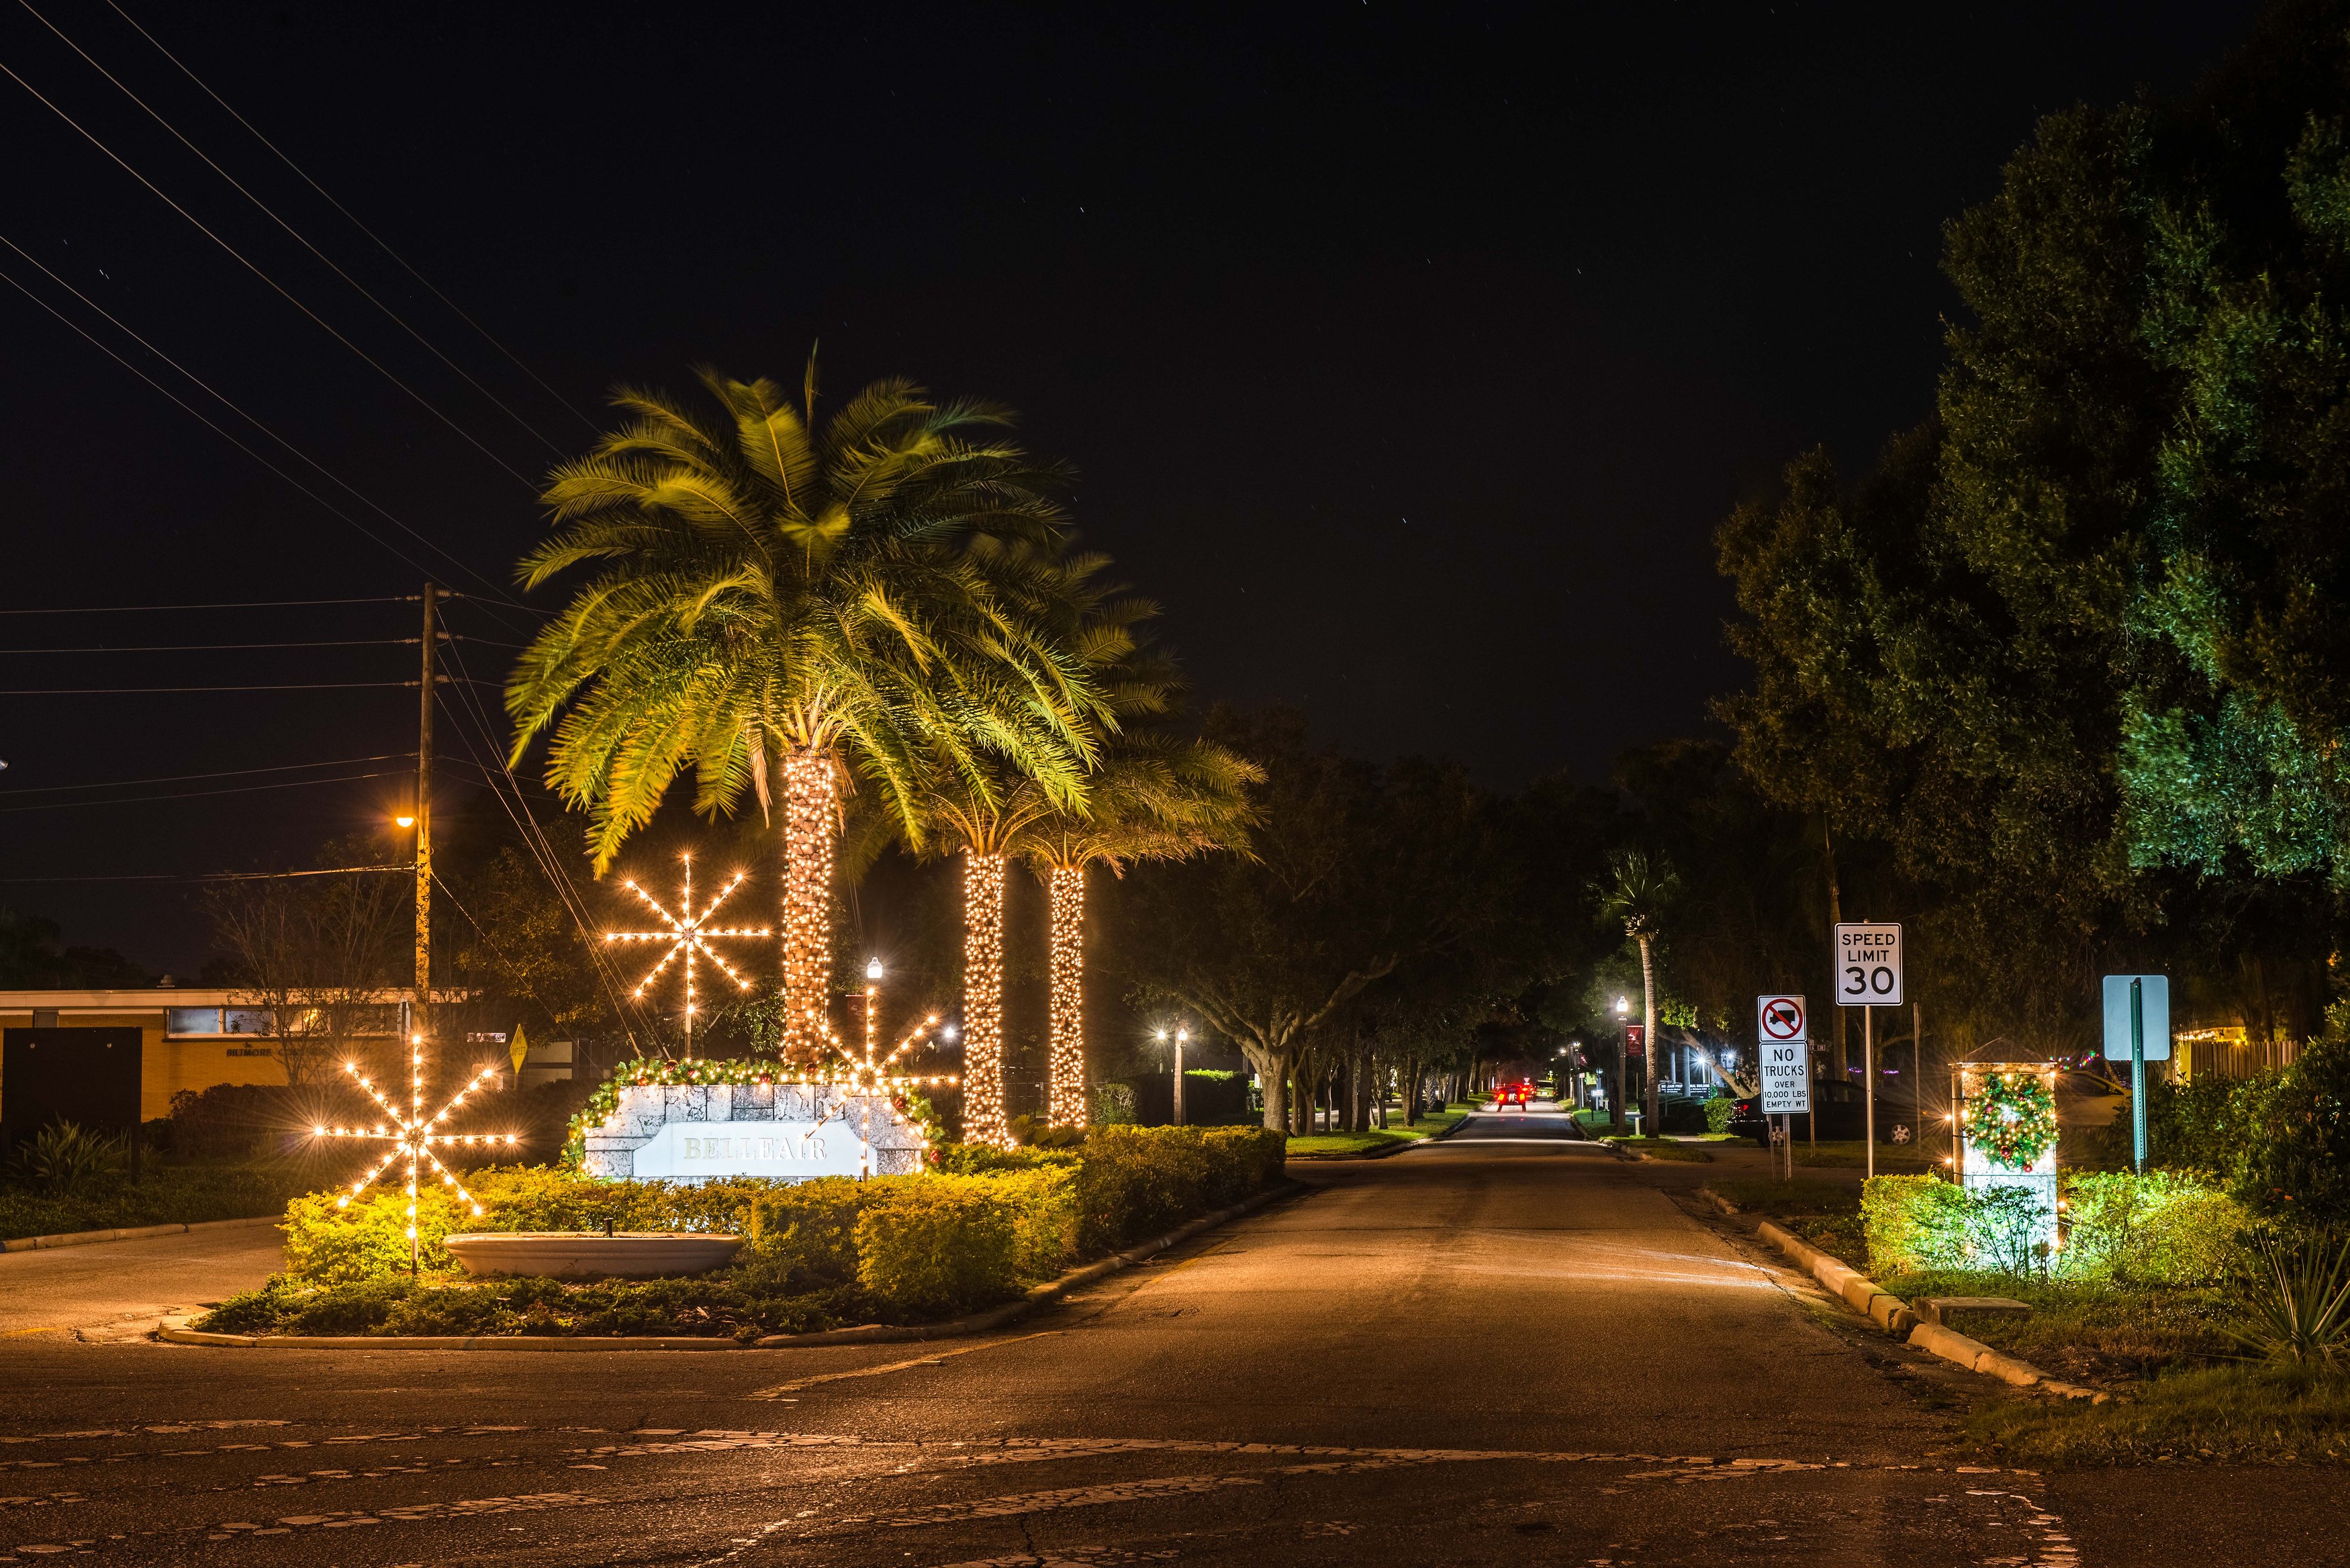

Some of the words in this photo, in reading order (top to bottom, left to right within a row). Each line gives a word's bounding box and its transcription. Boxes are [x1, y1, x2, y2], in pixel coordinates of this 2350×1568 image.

[1842, 934, 1895, 946] SPEED
[1848, 950, 1889, 962] LIMIT
[1844, 966, 1895, 995] 30
[516, 1036, 522, 1044] NO
[226, 1048, 271, 1057] BILTMORE
[511, 1046, 526, 1056] OUTLET
[1773, 1048, 1794, 1062] NO
[1764, 1065, 1804, 1077] TRUCKS
[1767, 1100, 1792, 1108] EMPTY
[684, 1137, 827, 1160] BELLEAIR
